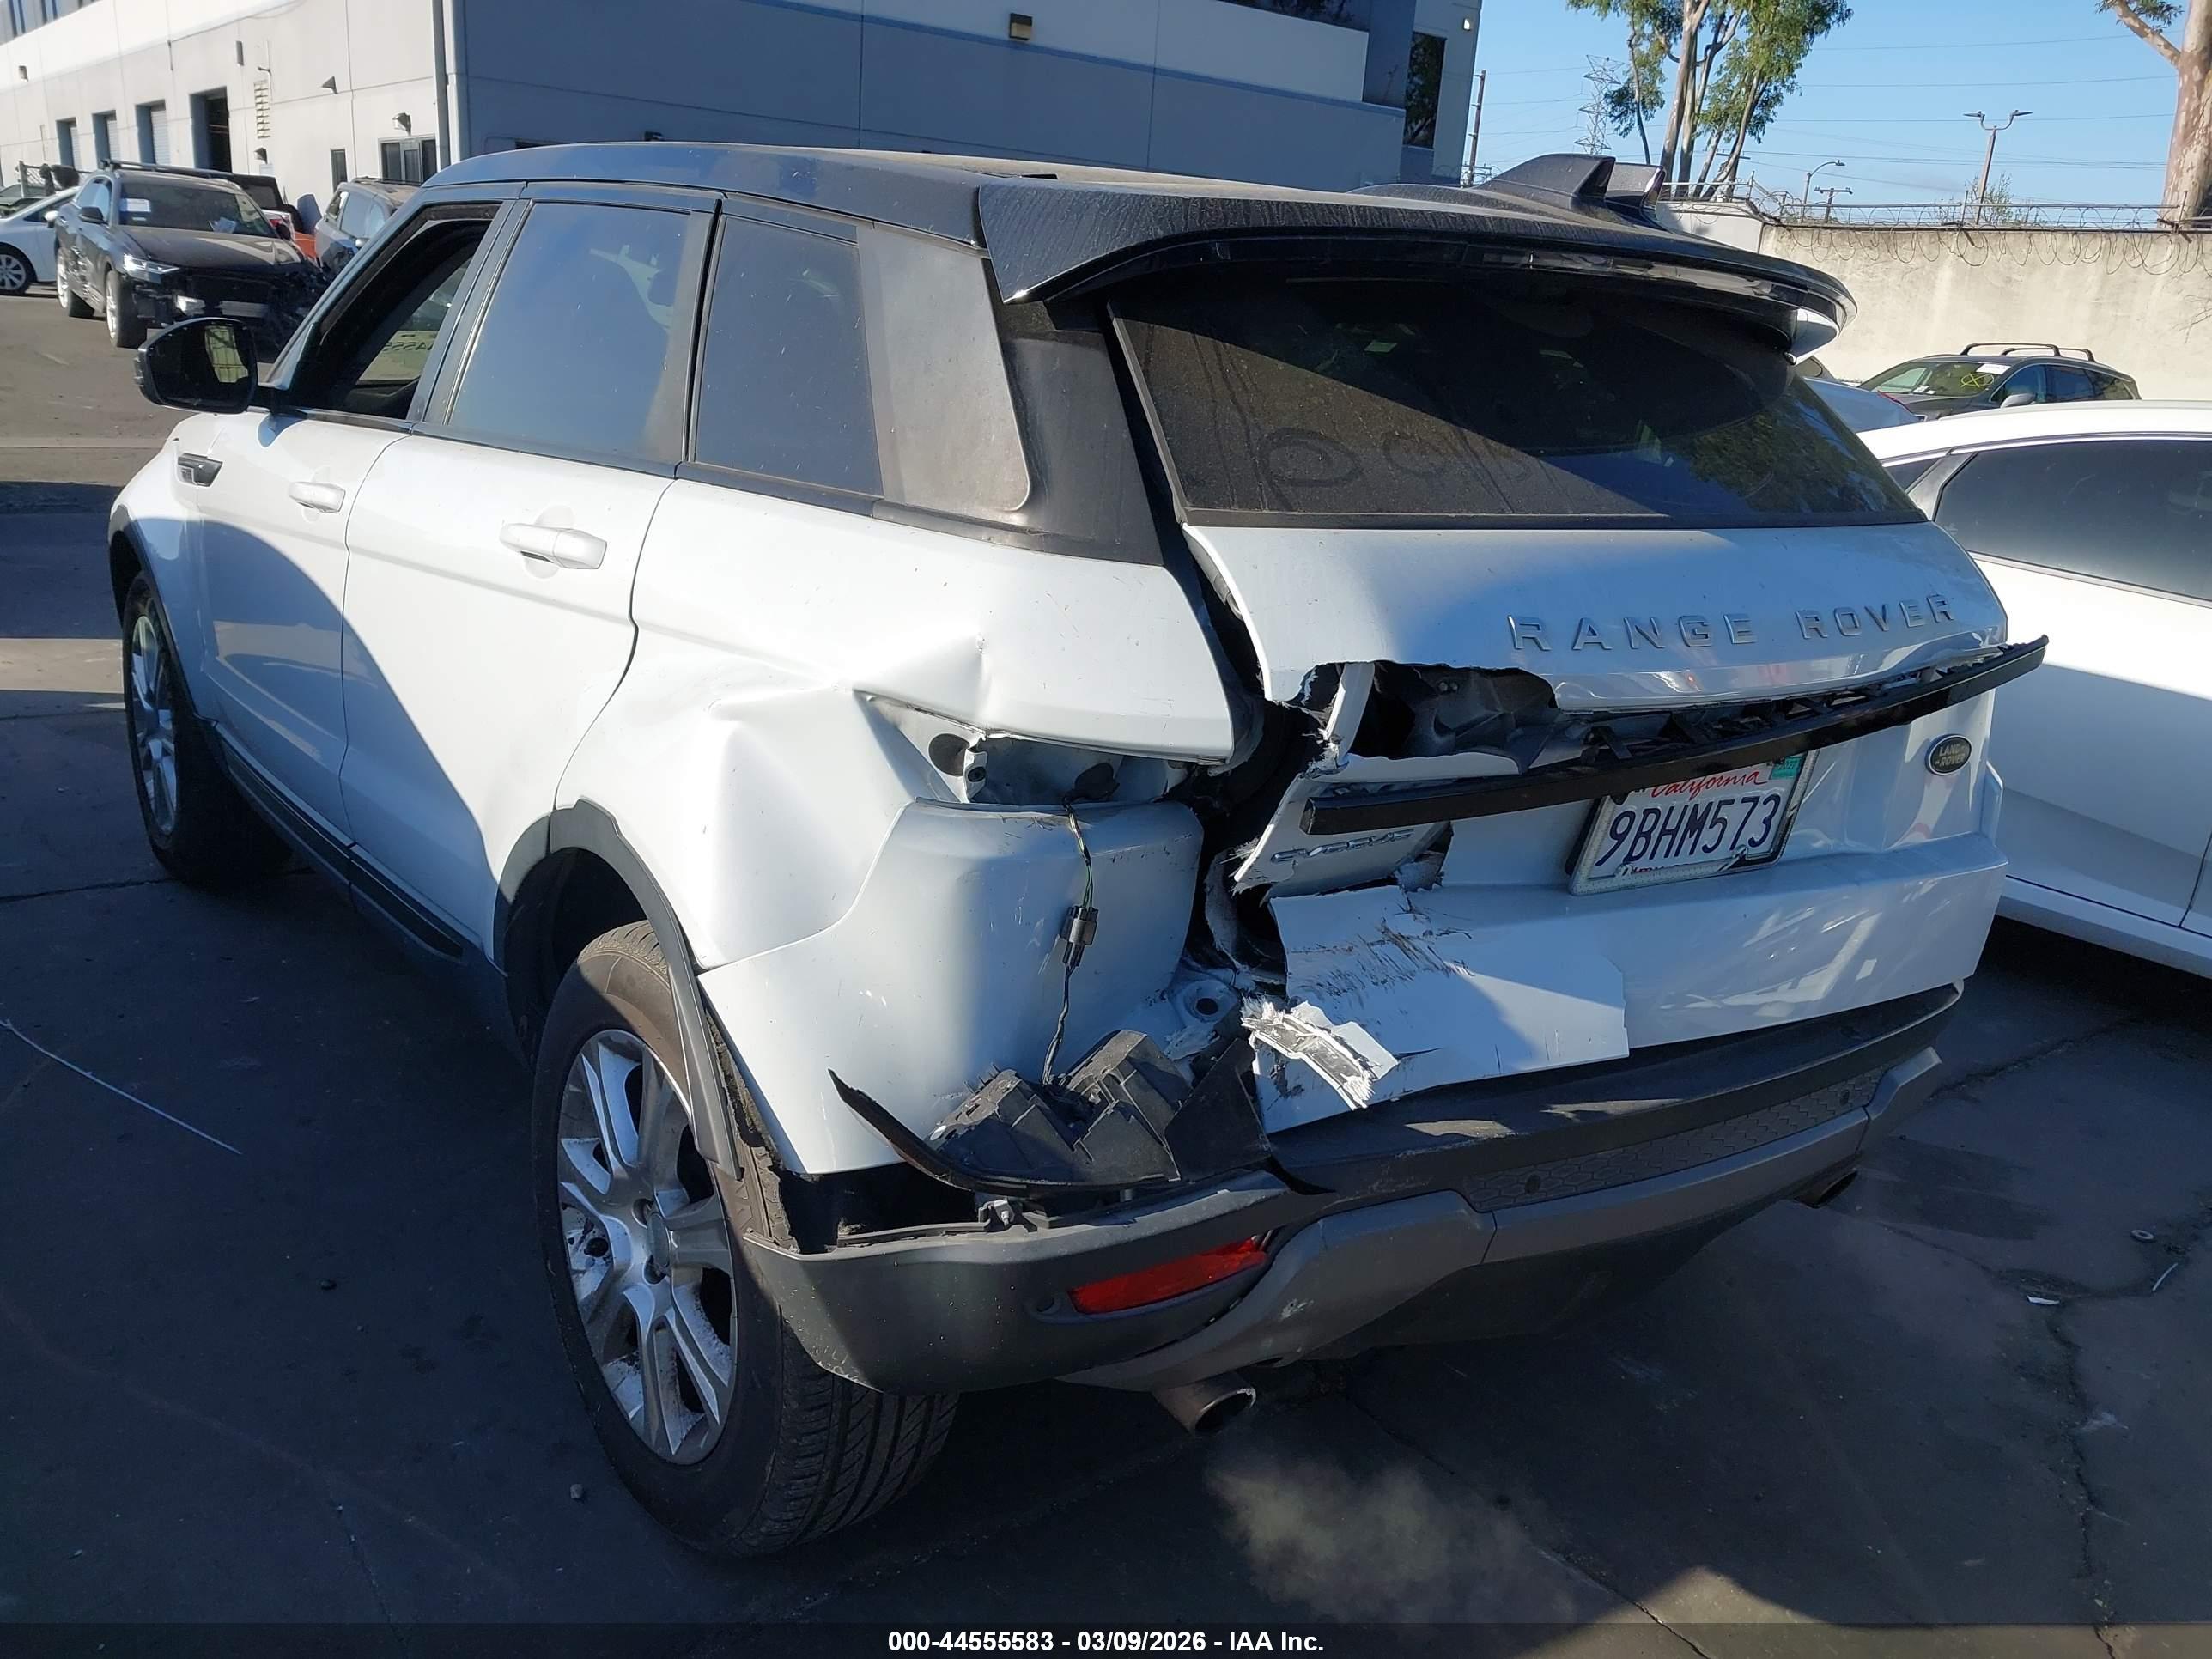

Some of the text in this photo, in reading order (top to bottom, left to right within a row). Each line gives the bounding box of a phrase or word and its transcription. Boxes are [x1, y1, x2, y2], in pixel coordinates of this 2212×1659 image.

[1507, 594, 1955, 651] RANGE ROVER
[1595, 793, 1782, 866] 9BHM573
